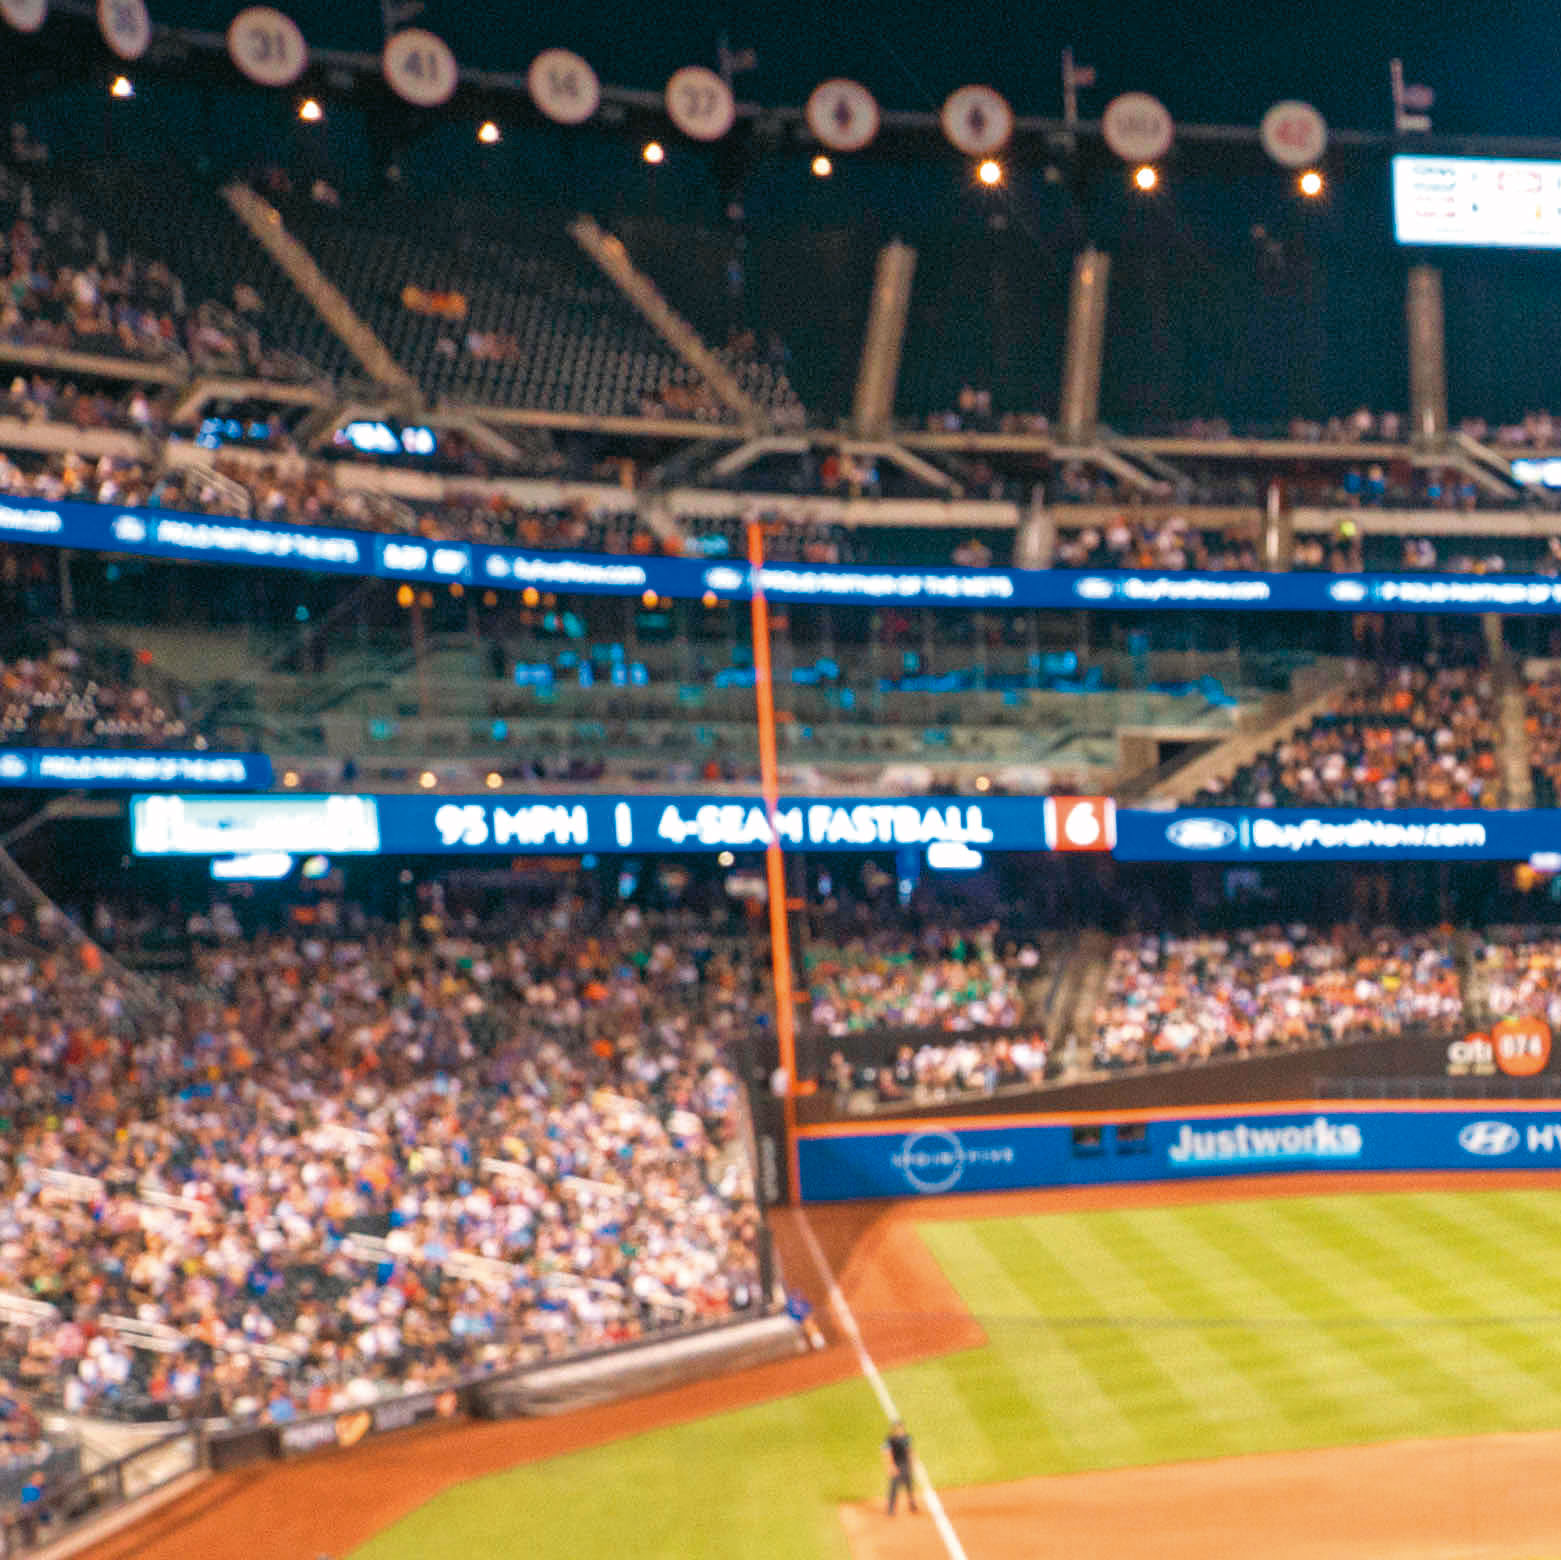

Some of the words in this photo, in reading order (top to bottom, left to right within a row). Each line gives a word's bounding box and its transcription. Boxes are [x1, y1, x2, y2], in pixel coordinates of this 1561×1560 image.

[435, 804, 489, 846] 95
[494, 804, 589, 846] MPH
[807, 804, 994, 844] FASTBALL
[1064, 802, 1100, 846] 6
[1253, 818, 1486, 850] BuyFordNow.com
[1168, 1116, 1362, 1165] Justworks
